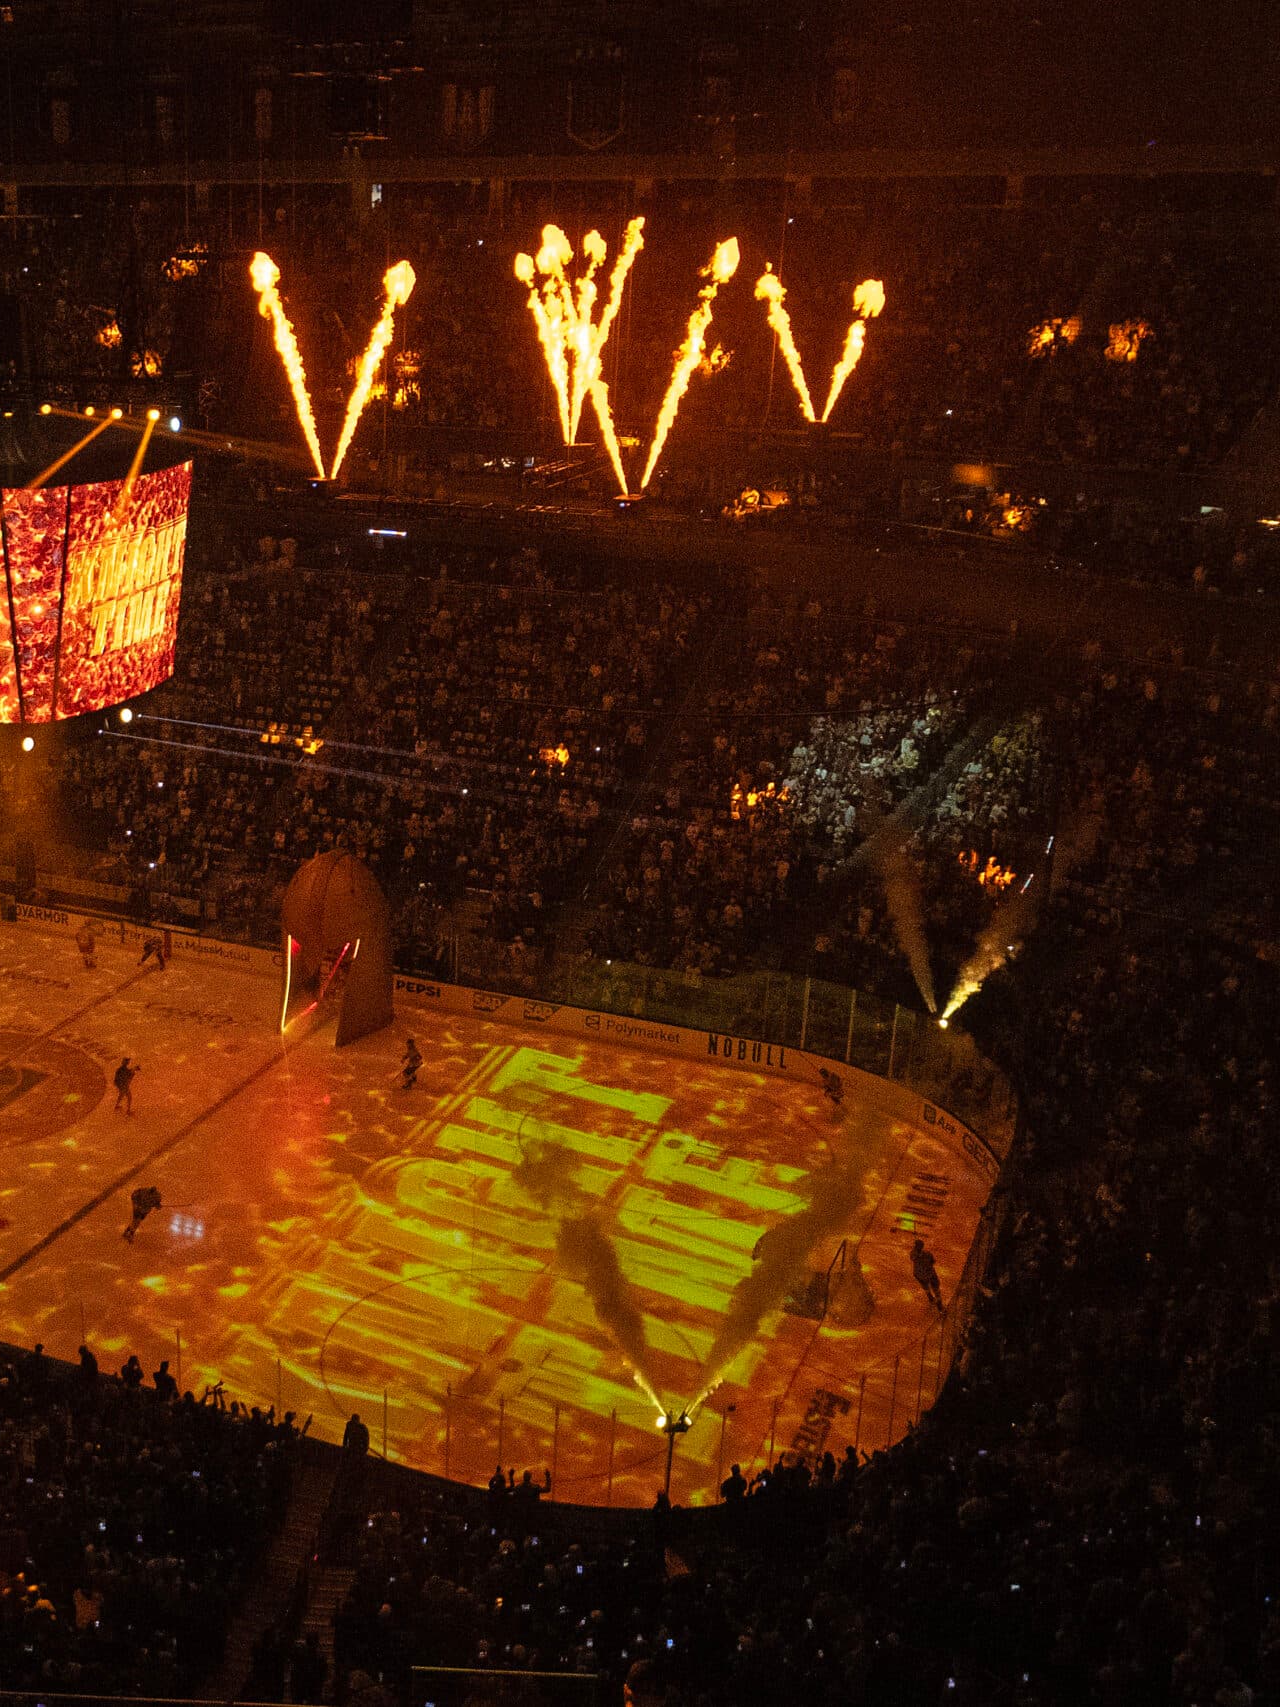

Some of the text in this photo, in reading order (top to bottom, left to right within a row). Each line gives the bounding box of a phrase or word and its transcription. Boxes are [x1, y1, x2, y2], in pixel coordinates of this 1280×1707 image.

[69, 516, 187, 605] KNIGHT
[90, 582, 171, 657] TIME
[396, 980, 441, 999] PEPSI
[605, 1019, 680, 1045] Polymarket
[706, 1033, 788, 1070] NOBULL
